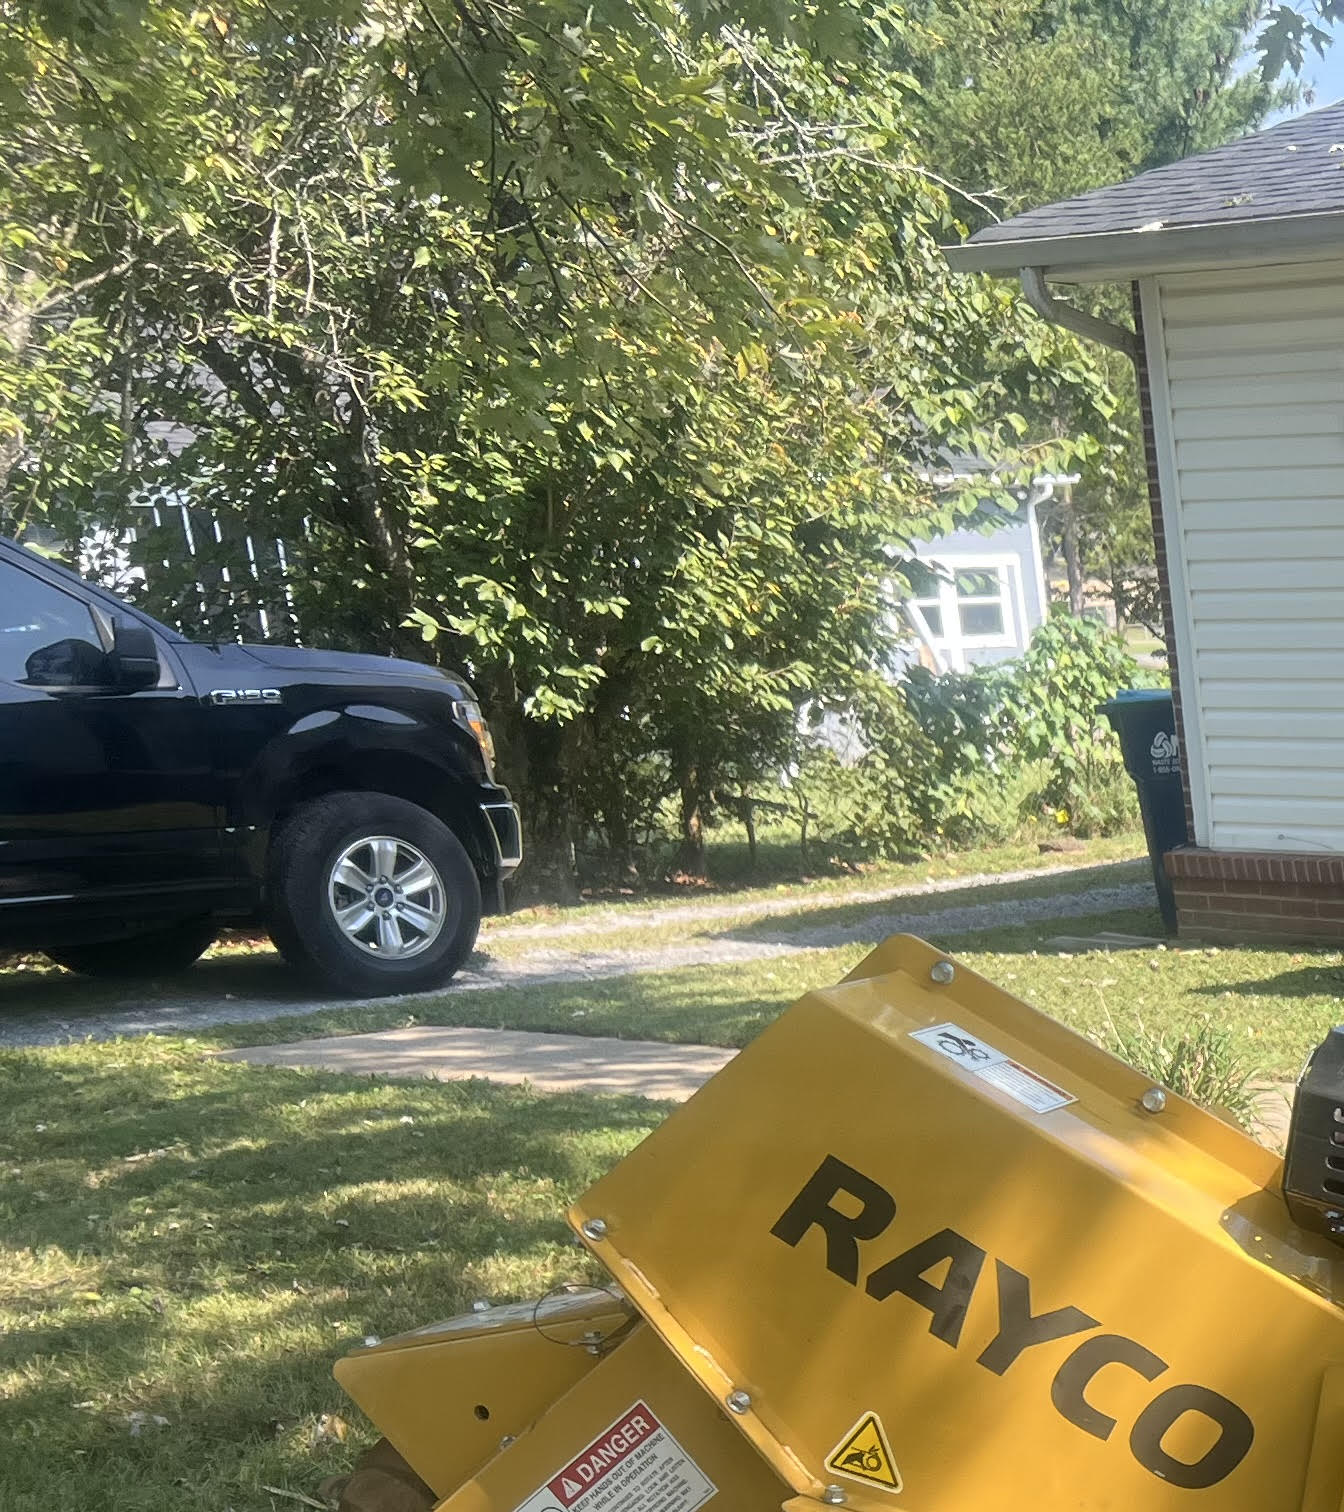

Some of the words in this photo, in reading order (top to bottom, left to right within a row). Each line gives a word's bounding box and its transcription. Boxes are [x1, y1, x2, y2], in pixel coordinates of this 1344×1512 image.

[770, 1154, 1254, 1489] RAYCO
[575, 1412, 651, 1484] DANGER
[588, 1476, 613, 1500] HANDS
[610, 1464, 627, 1481] OUT
[624, 1456, 636, 1469] OF
[633, 1431, 665, 1461] MACHINE
[592, 1489, 615, 1512] WHILE
[612, 1483, 623, 1494] IN
[619, 1451, 659, 1488] OPERATION
